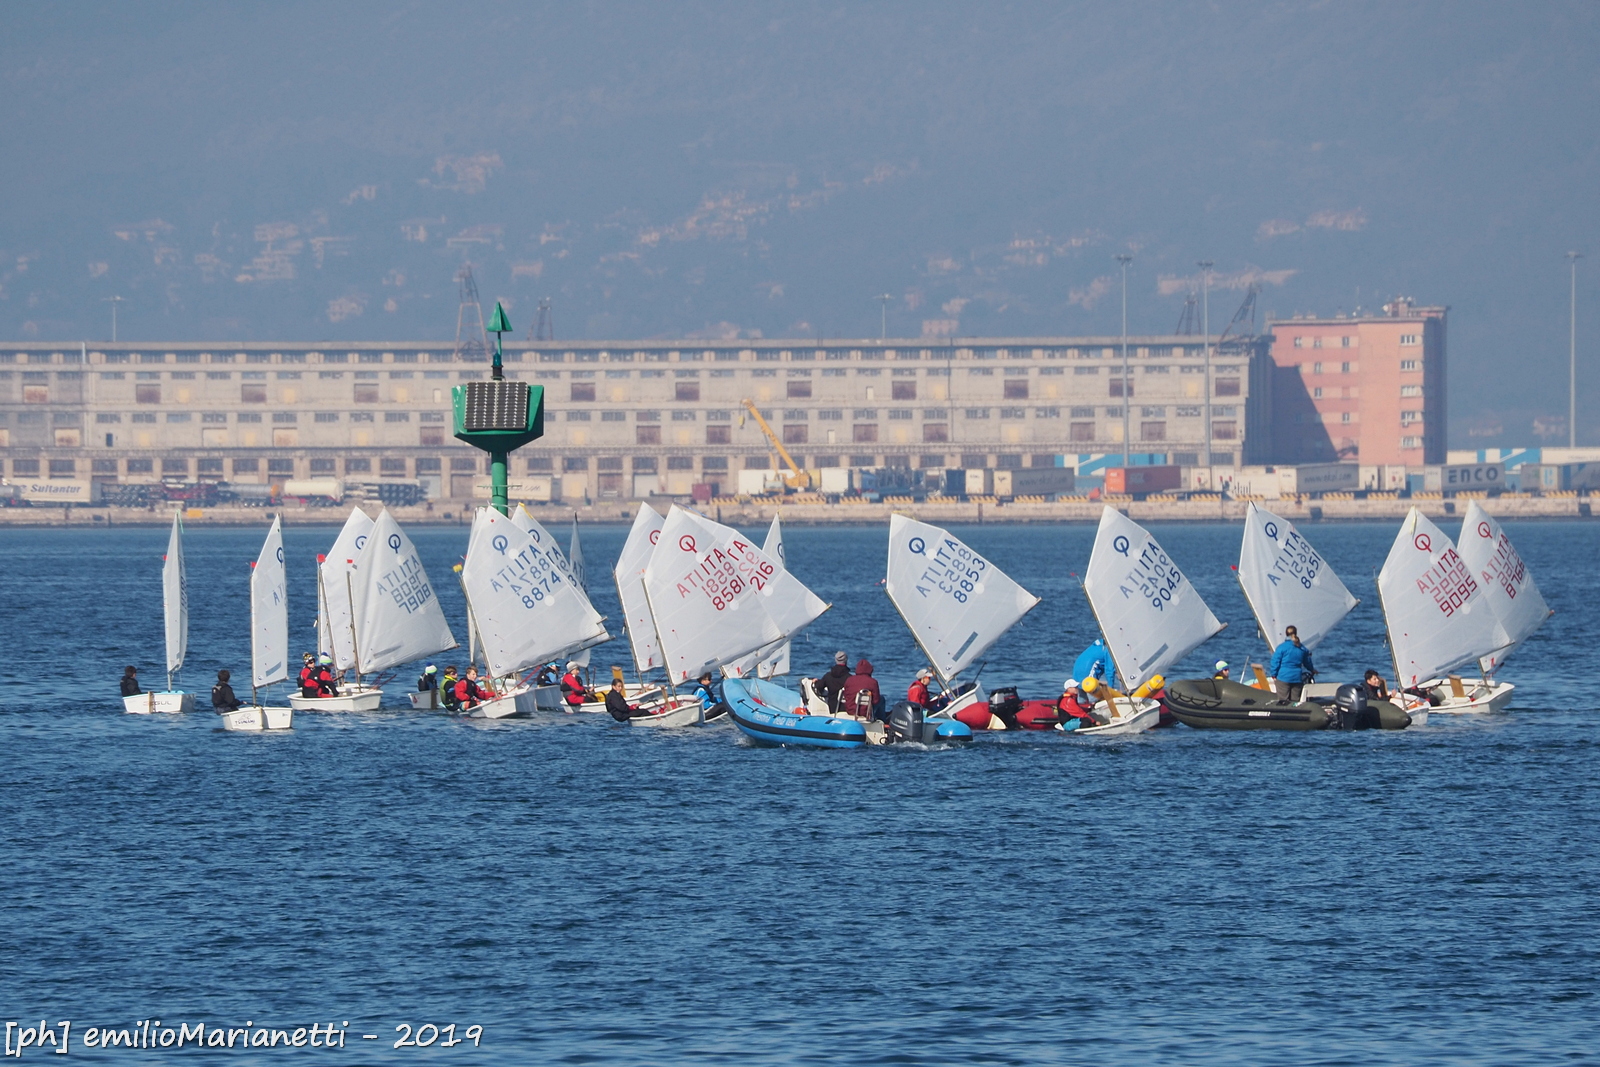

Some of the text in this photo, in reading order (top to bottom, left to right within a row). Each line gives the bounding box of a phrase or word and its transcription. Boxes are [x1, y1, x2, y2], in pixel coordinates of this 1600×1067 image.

[515, 544, 541, 571] ITA
[934, 538, 959, 568] ITA
[1139, 541, 1160, 570] ITA
[1282, 530, 1301, 558] ITA
[1497, 533, 1511, 560] ITA
[401, 554, 420, 578] ITA
[700, 547, 726, 575] ITA
[1300, 551, 1321, 590] 8651
[1437, 547, 1460, 574] ITA
[522, 570, 561, 610] 8874
[712, 574, 746, 611] 8581
[749, 561, 774, 594] 216
[953, 557, 985, 603] 8853
[1152, 566, 1181, 612] 9045
[399, 583, 432, 614] 7908
[1439, 575, 1478, 618] 9095
